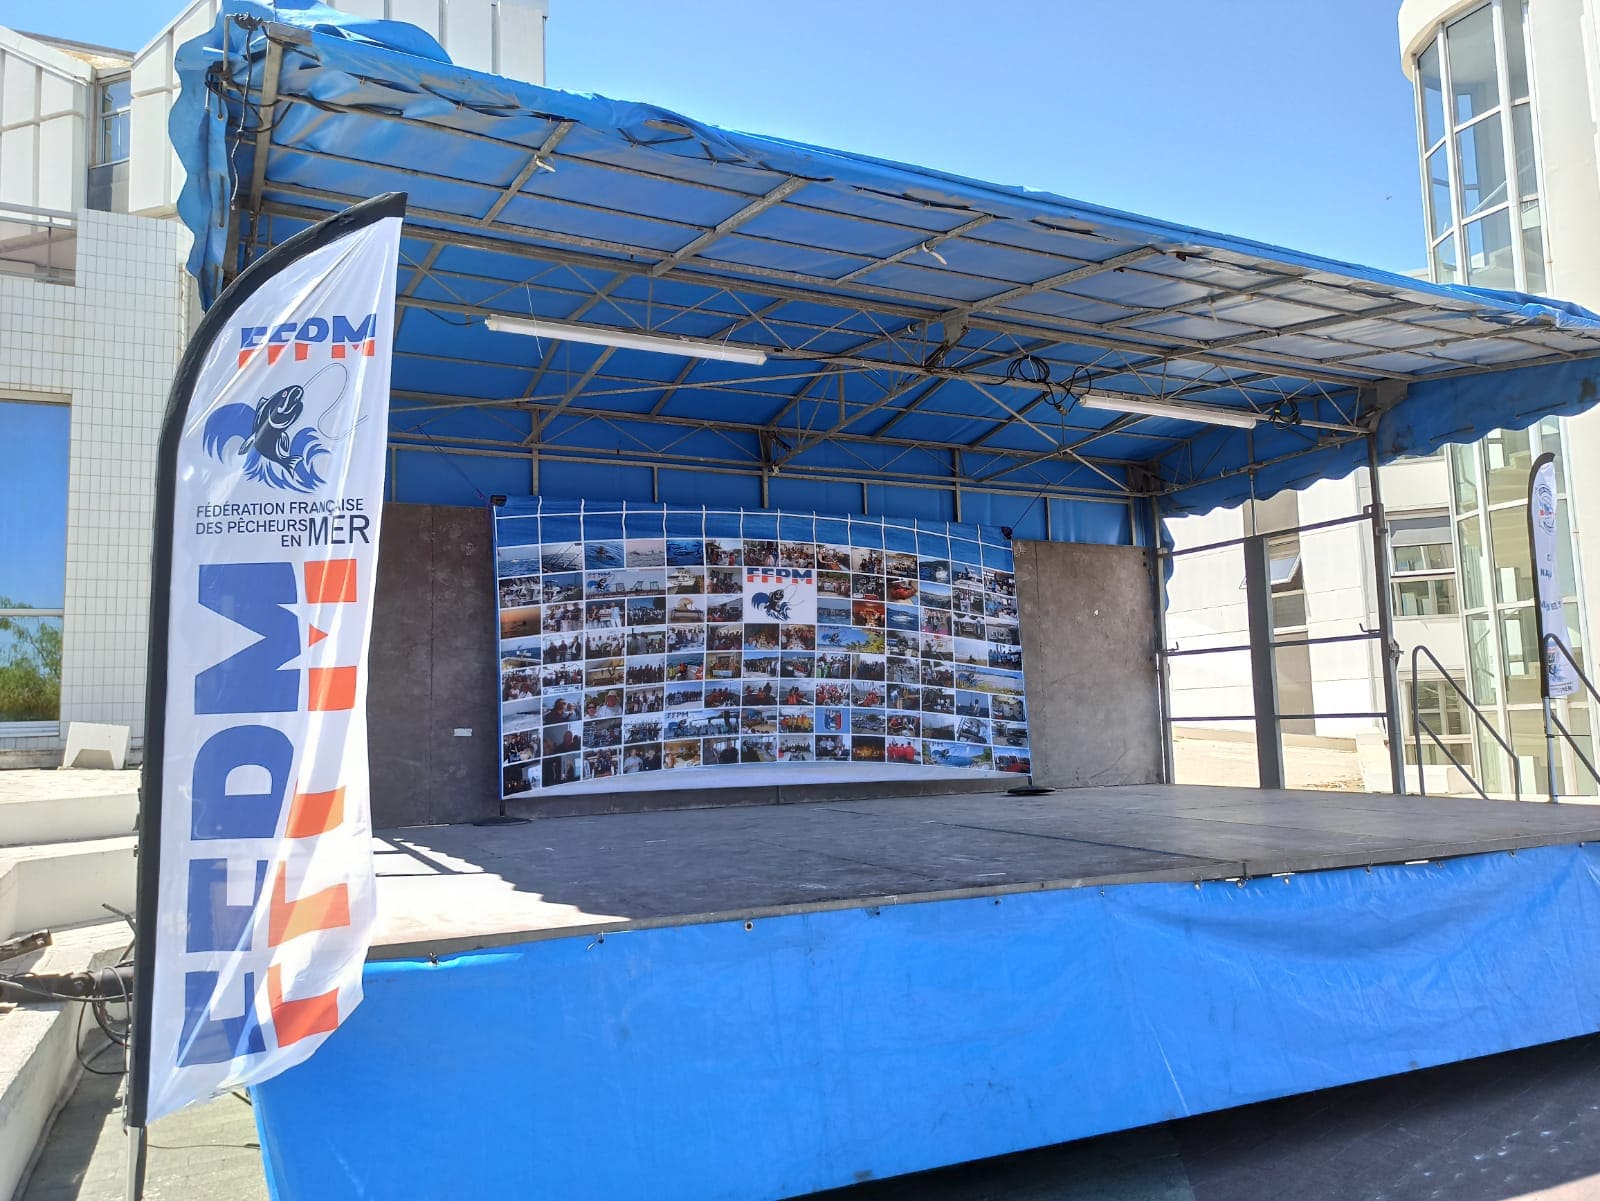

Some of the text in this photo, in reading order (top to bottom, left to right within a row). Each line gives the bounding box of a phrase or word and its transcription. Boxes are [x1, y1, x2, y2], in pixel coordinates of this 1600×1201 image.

[238, 314, 376, 369] FFPM
[196, 501, 285, 518] FÉDÉRATION
[196, 518, 308, 535] DES PÊCHEURS
[281, 514, 370, 547] EN MER
[747, 567, 813, 584] FFPM
